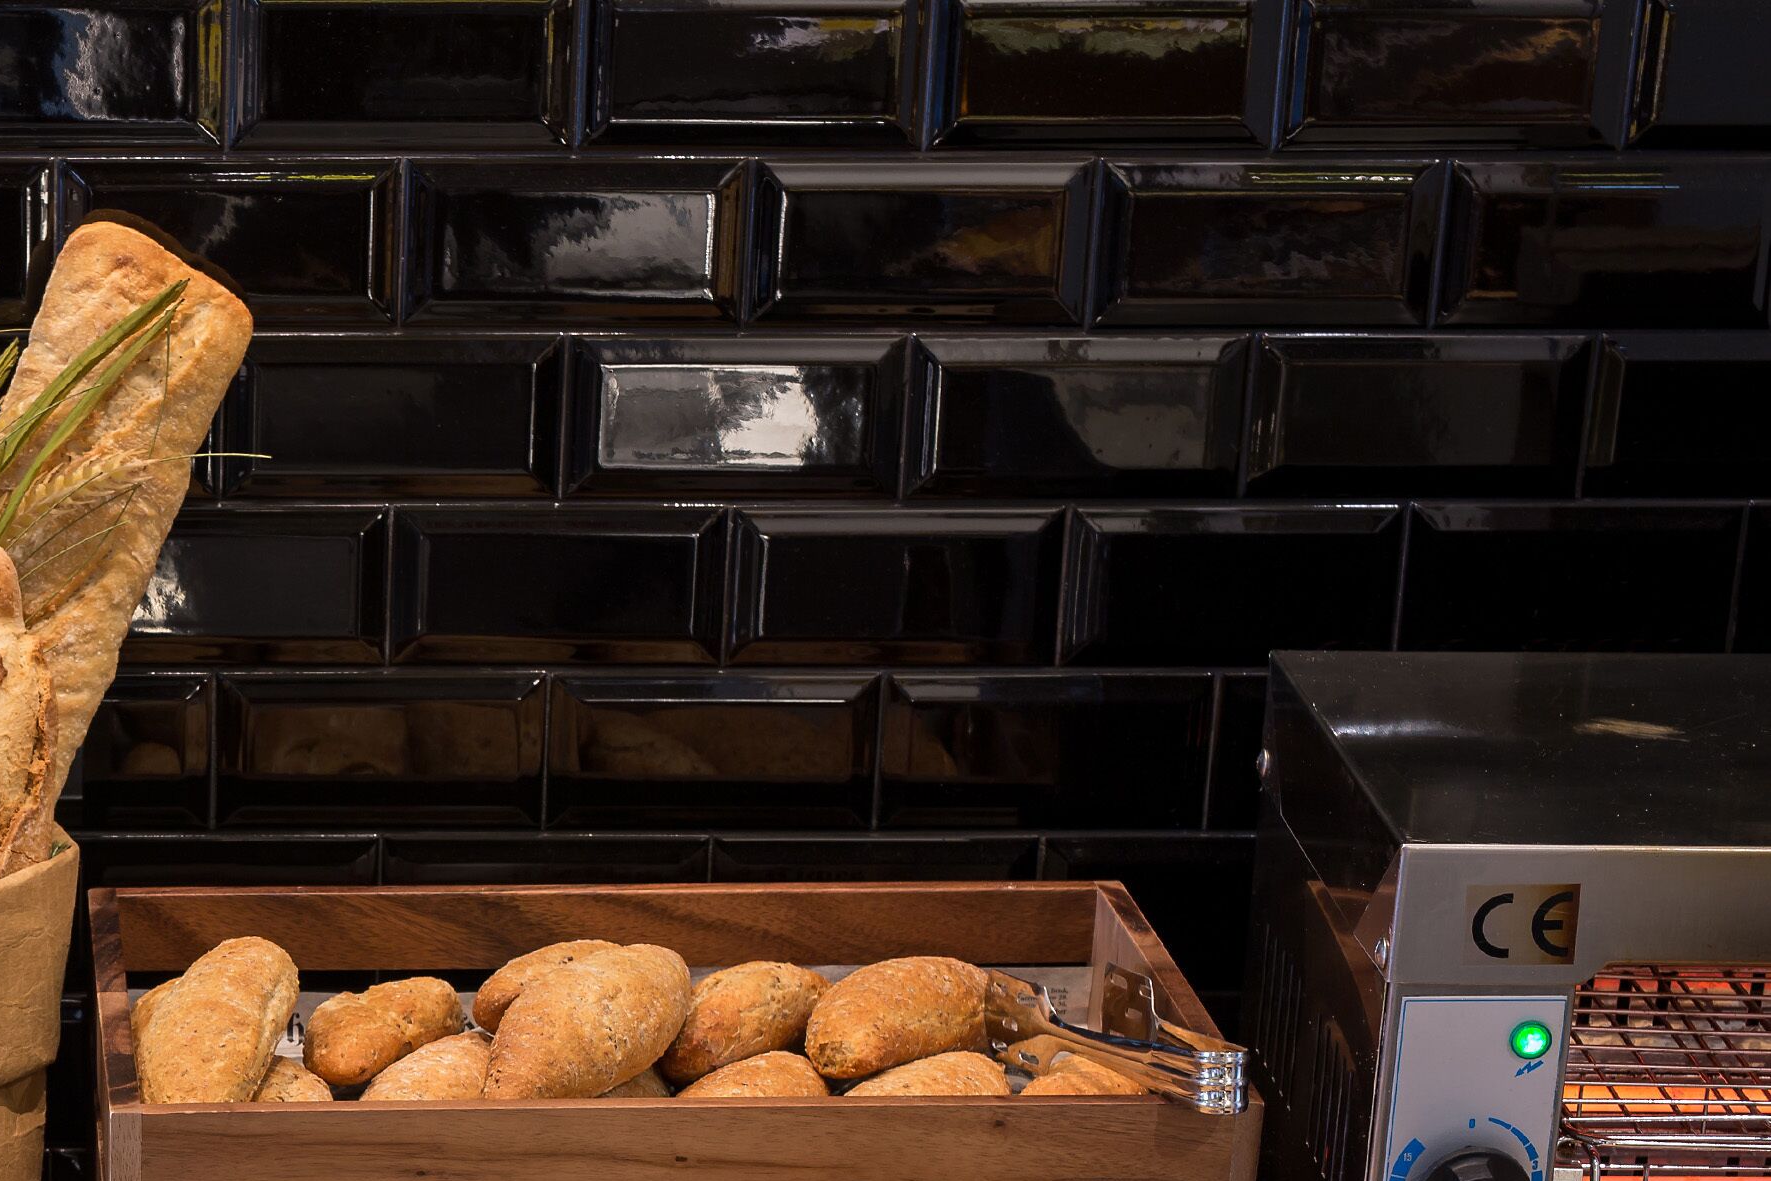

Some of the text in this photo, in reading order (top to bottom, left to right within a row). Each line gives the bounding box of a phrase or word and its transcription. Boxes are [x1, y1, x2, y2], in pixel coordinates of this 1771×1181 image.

[1471, 891, 1574, 959] CE
[1403, 1152, 1412, 1162] 15
[1531, 1160, 1539, 1170] 3
